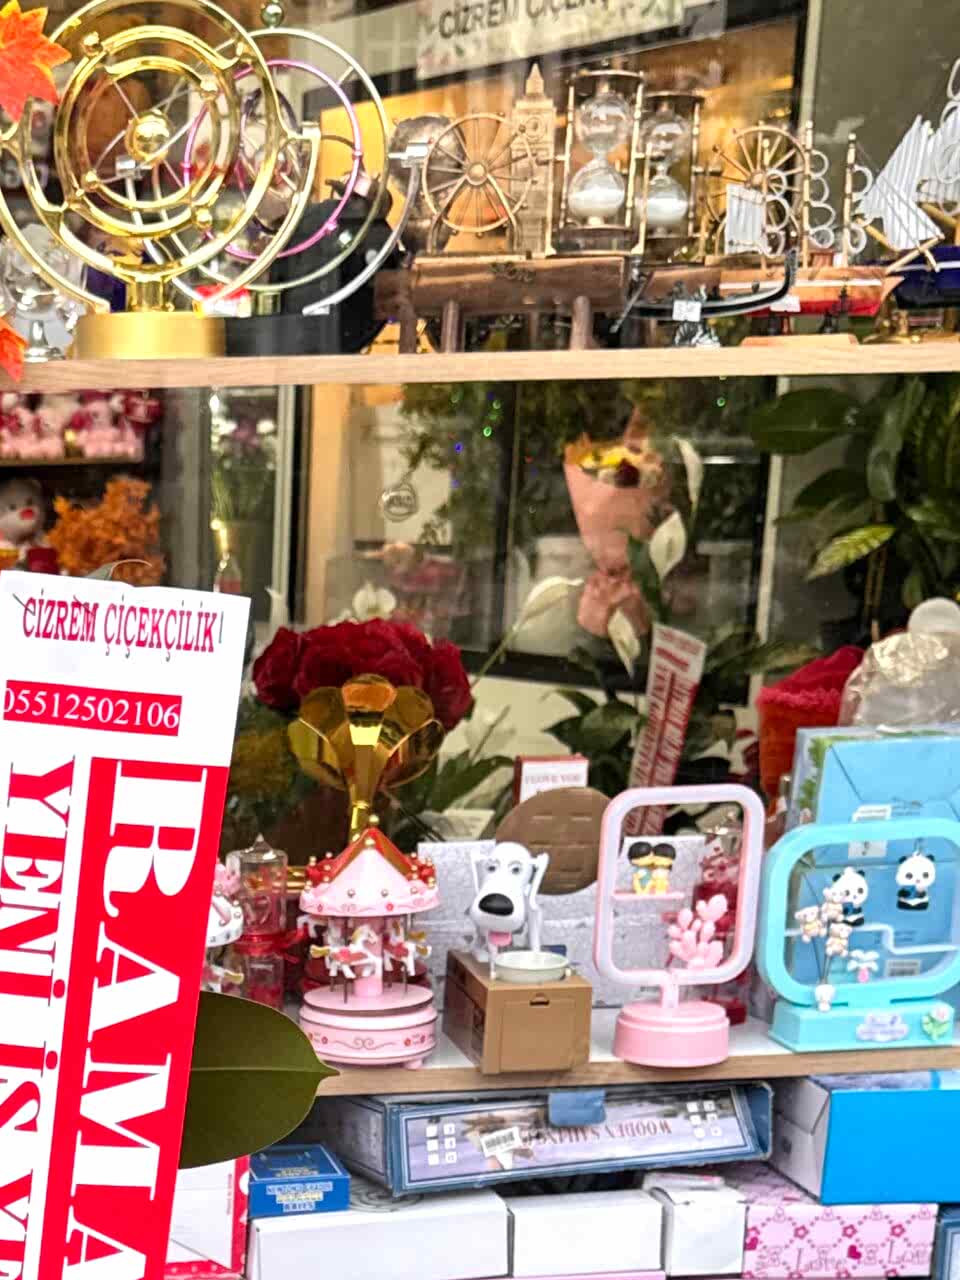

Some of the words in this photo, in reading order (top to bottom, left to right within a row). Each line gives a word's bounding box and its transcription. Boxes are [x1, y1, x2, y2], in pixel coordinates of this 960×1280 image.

[22, 588, 100, 642] CİZREM
[103, 594, 219, 662] ÇİÇEKÇİLİK
[3, 687, 180, 730] 05512502106
